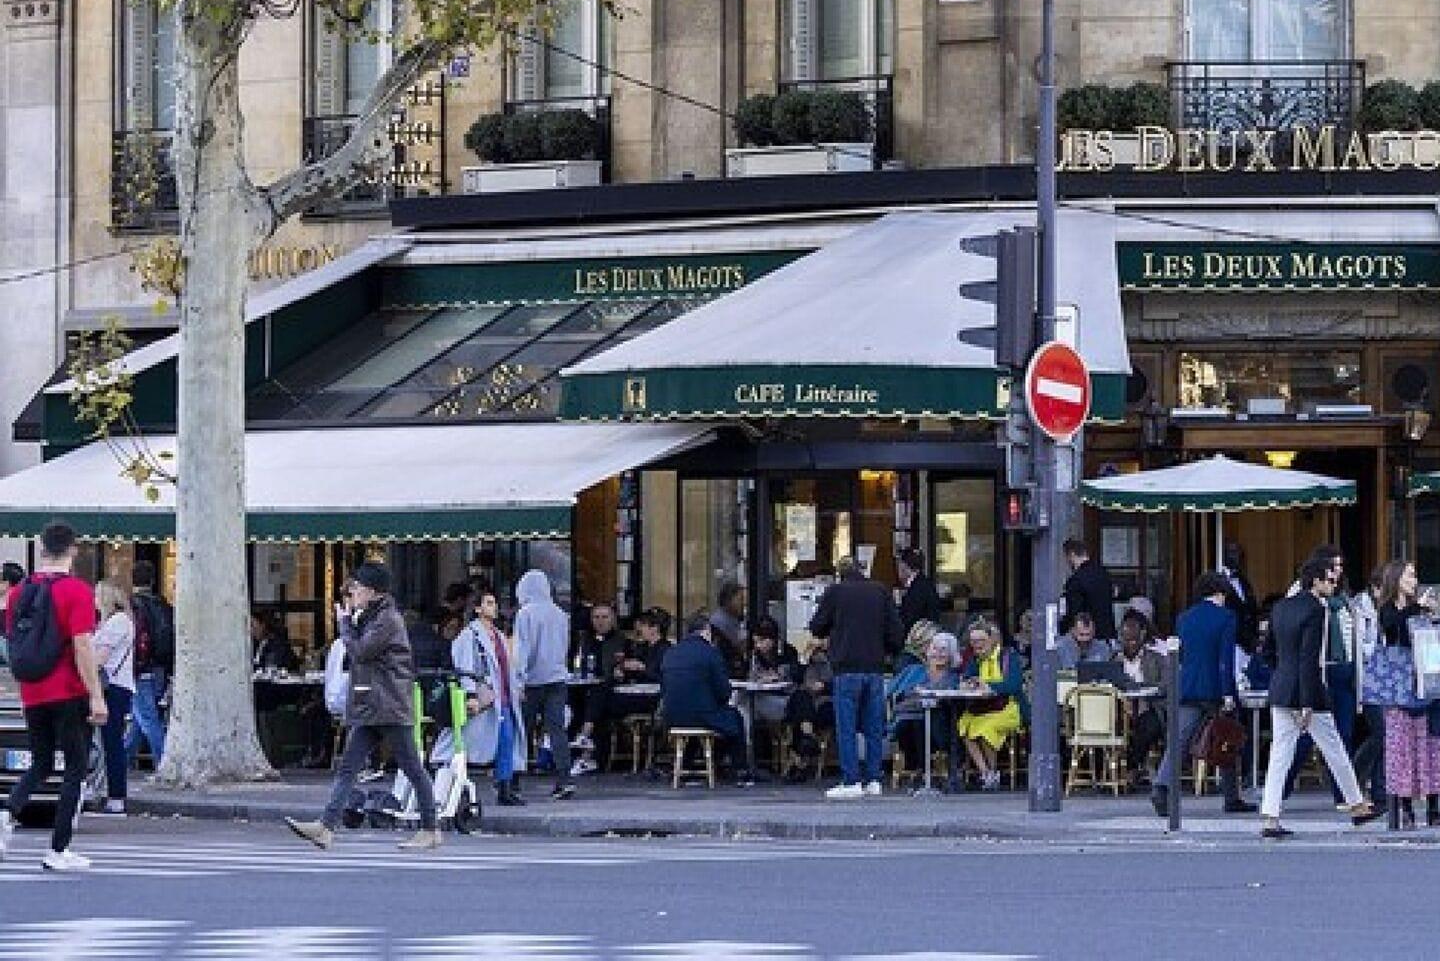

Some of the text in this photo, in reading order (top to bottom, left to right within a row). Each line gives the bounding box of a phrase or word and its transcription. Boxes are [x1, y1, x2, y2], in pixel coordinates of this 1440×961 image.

[1053, 127, 1113, 172] ES
[1132, 124, 1276, 172] DEUX
[574, 264, 745, 294] LES DEUX MAGOTS
[1142, 251, 1407, 279] LES DEUX MAGOTS
